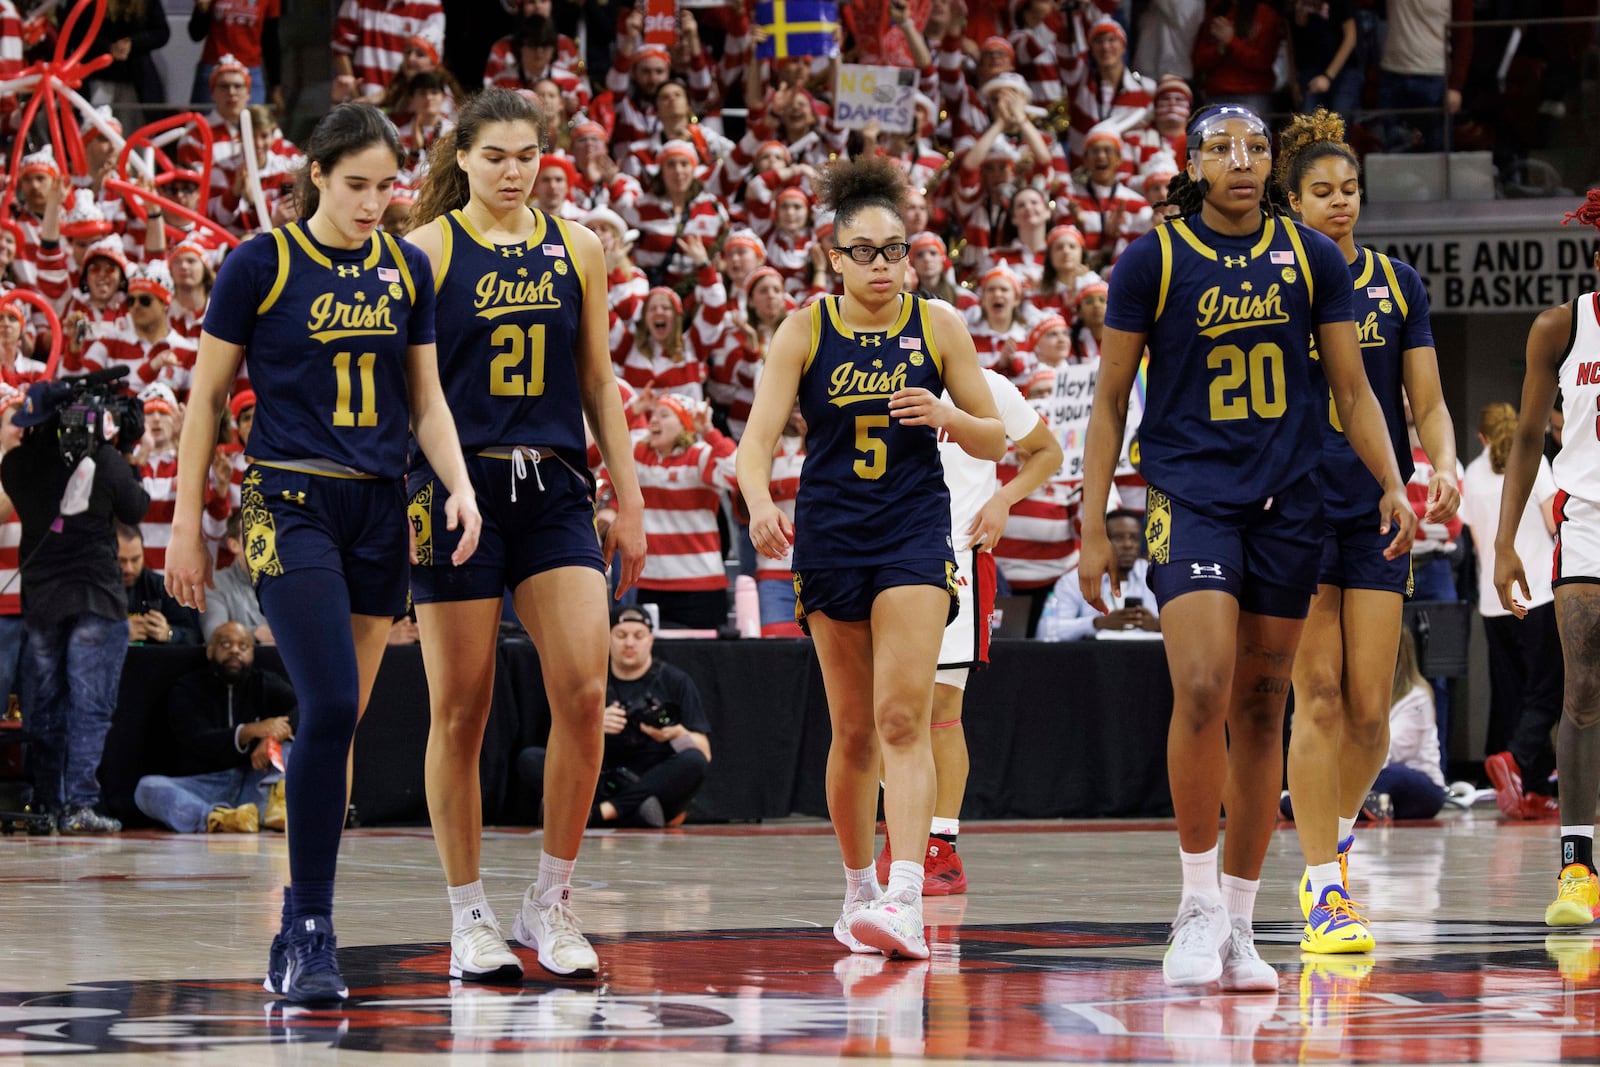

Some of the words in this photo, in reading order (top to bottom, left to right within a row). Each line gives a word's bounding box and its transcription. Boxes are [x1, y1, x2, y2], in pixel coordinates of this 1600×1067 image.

[841, 71, 876, 94] NO
[837, 101, 909, 127] DAMES
[1473, 239, 1544, 272] AND
[307, 291, 398, 345] Irish
[474, 270, 562, 321] Irish
[1196, 282, 1290, 340] Irish
[489, 323, 546, 397] 21
[827, 361, 908, 408] Irish
[1056, 373, 1086, 399] Hey
[1206, 341, 1288, 422] 20
[332, 351, 379, 428] 11
[853, 414, 890, 481] 5
